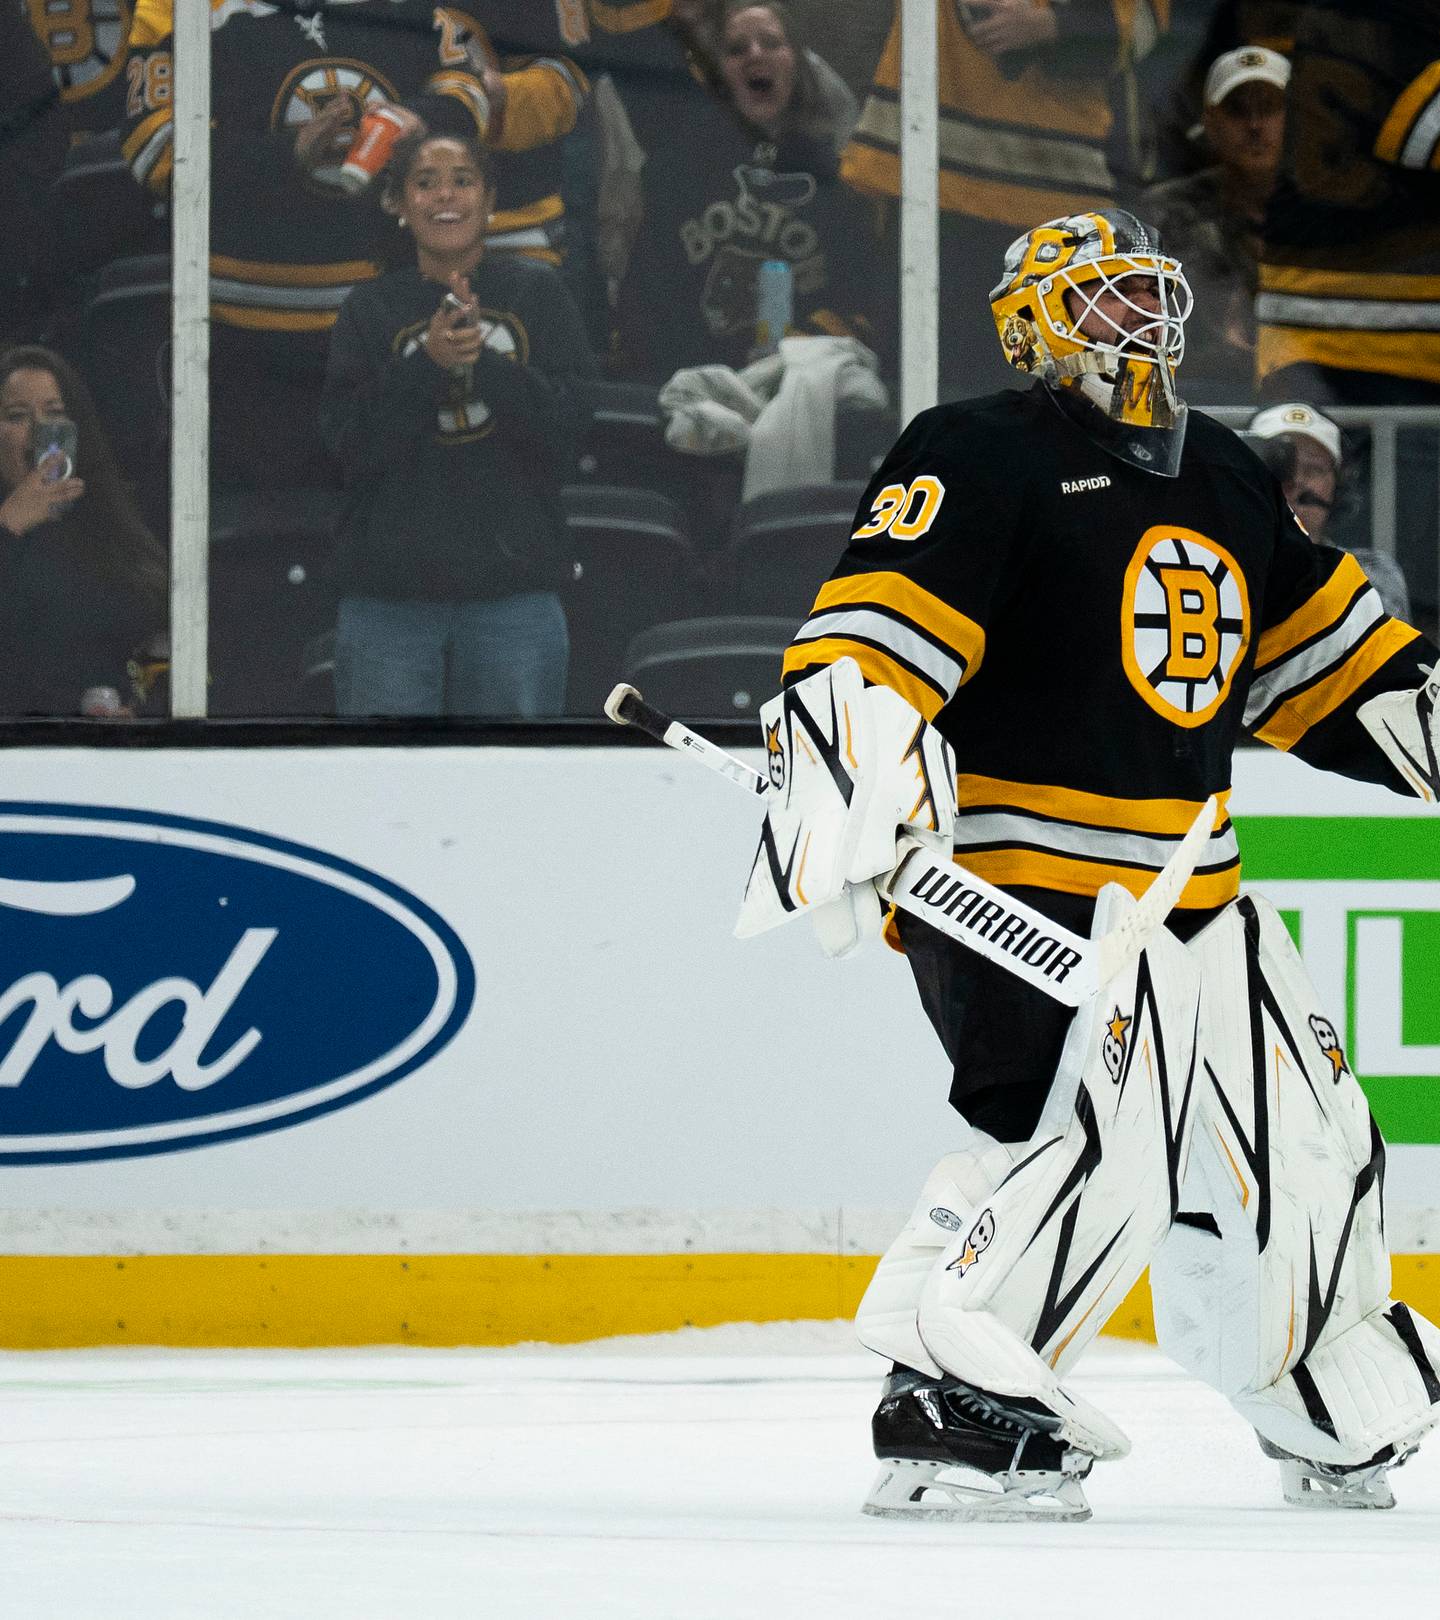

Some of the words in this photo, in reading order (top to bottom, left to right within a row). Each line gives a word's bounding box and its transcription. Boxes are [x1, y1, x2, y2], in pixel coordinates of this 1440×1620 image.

[851, 475, 946, 541] 30
[1159, 568, 1219, 680] B
[908, 865, 1083, 984] WARRIOR
